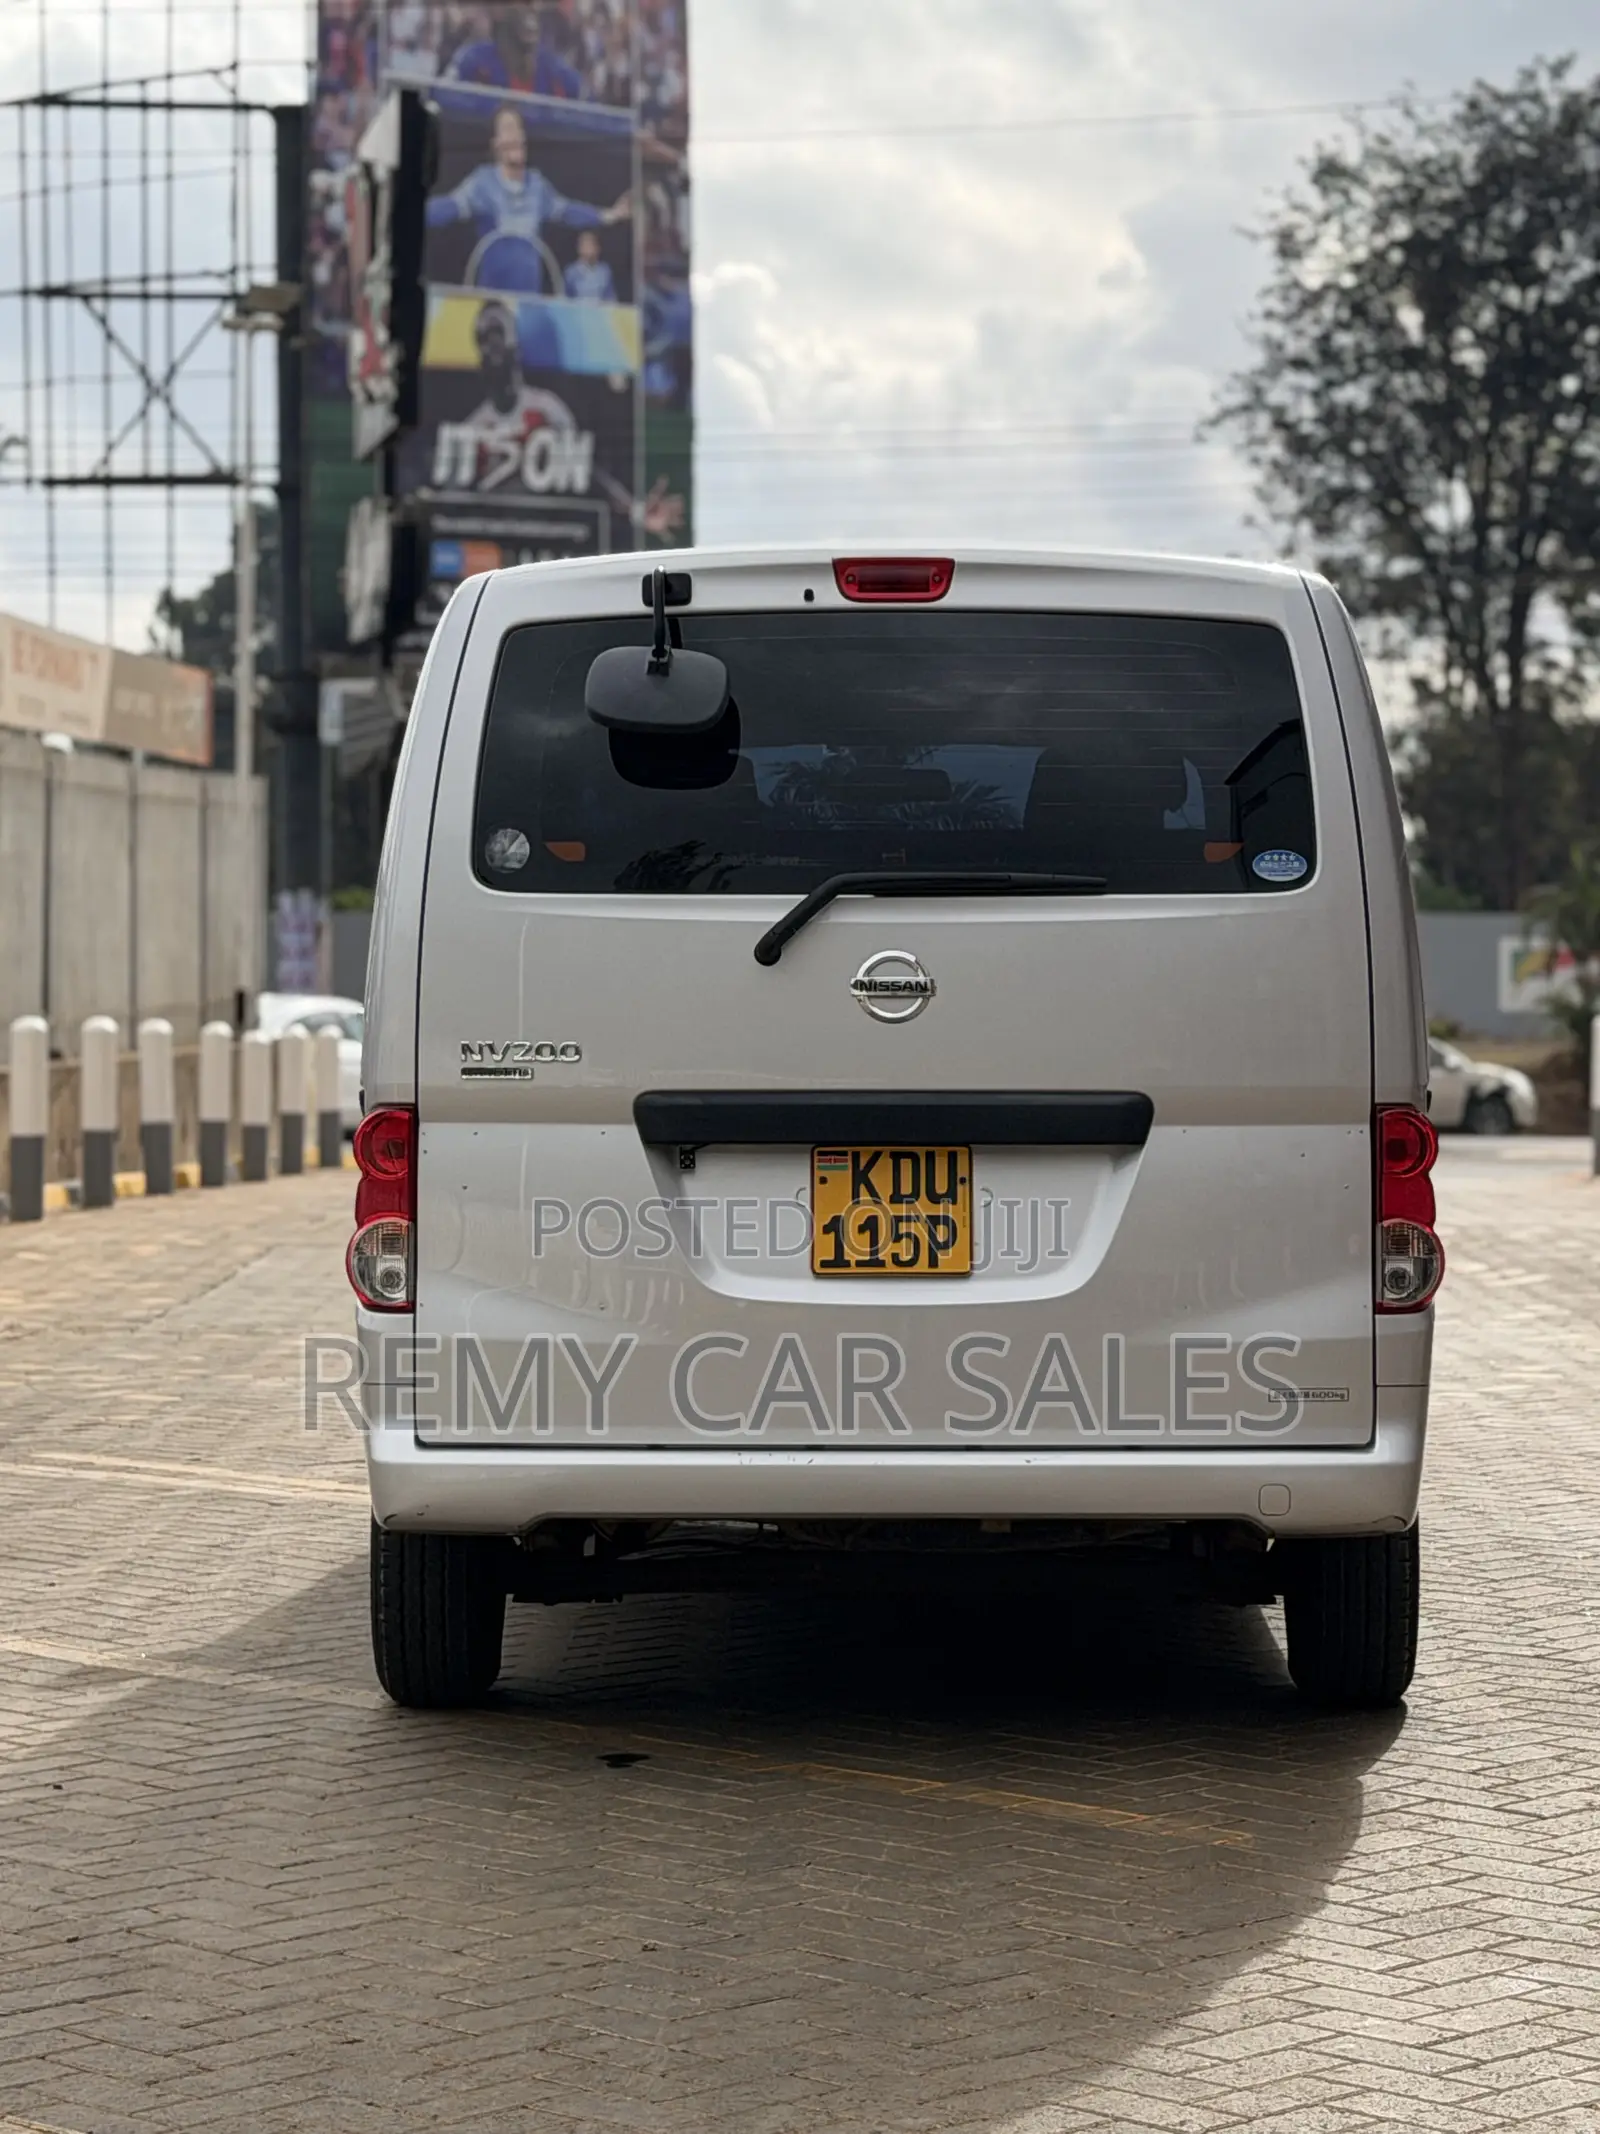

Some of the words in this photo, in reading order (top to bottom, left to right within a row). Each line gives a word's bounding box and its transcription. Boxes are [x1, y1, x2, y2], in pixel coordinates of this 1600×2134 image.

[860, 980, 929, 992] NISSAN
[460, 1040, 582, 1062] NV200
[851, 1150, 958, 1205] KDU
[819, 1215, 958, 1269] 115P
